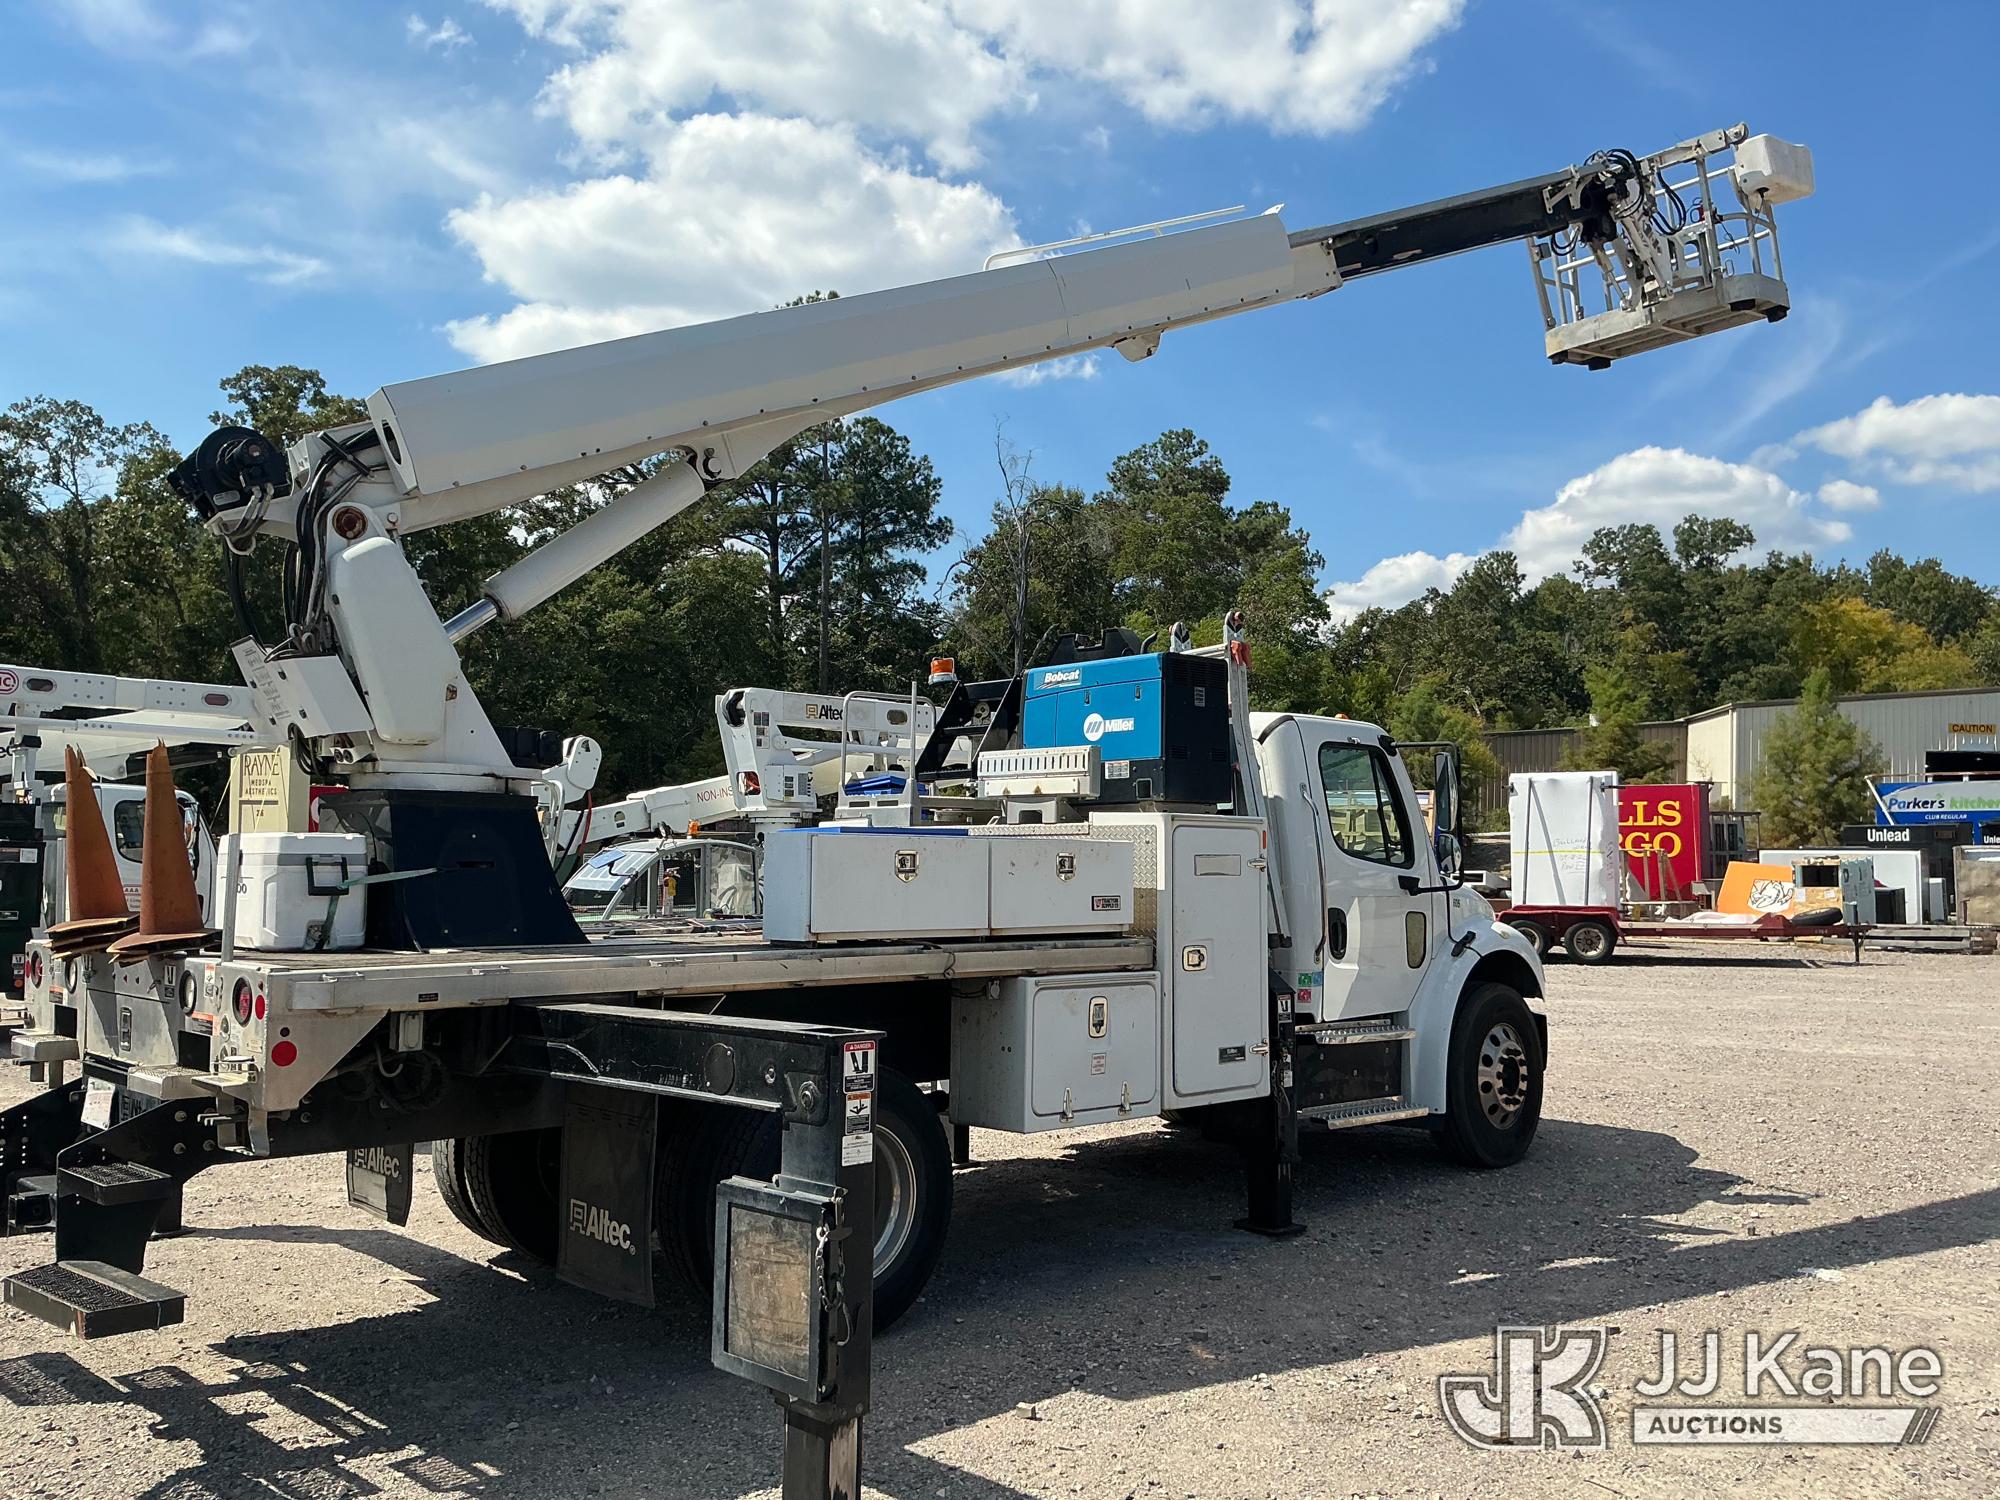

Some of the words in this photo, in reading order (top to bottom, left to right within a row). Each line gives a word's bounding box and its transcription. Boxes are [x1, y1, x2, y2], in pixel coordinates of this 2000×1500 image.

[1045, 669, 1080, 683] Bobcat
[1105, 719, 1133, 732] Miller
[1952, 724, 1993, 734] CAUTION
[244, 754, 280, 776] RAYNE
[251, 778, 272, 786] MEDSPA
[1867, 828, 1910, 843] Unlead
[1619, 832, 1682, 858] GO
[367, 1147, 400, 1178] Altec
[586, 1206, 631, 1250] Altec
